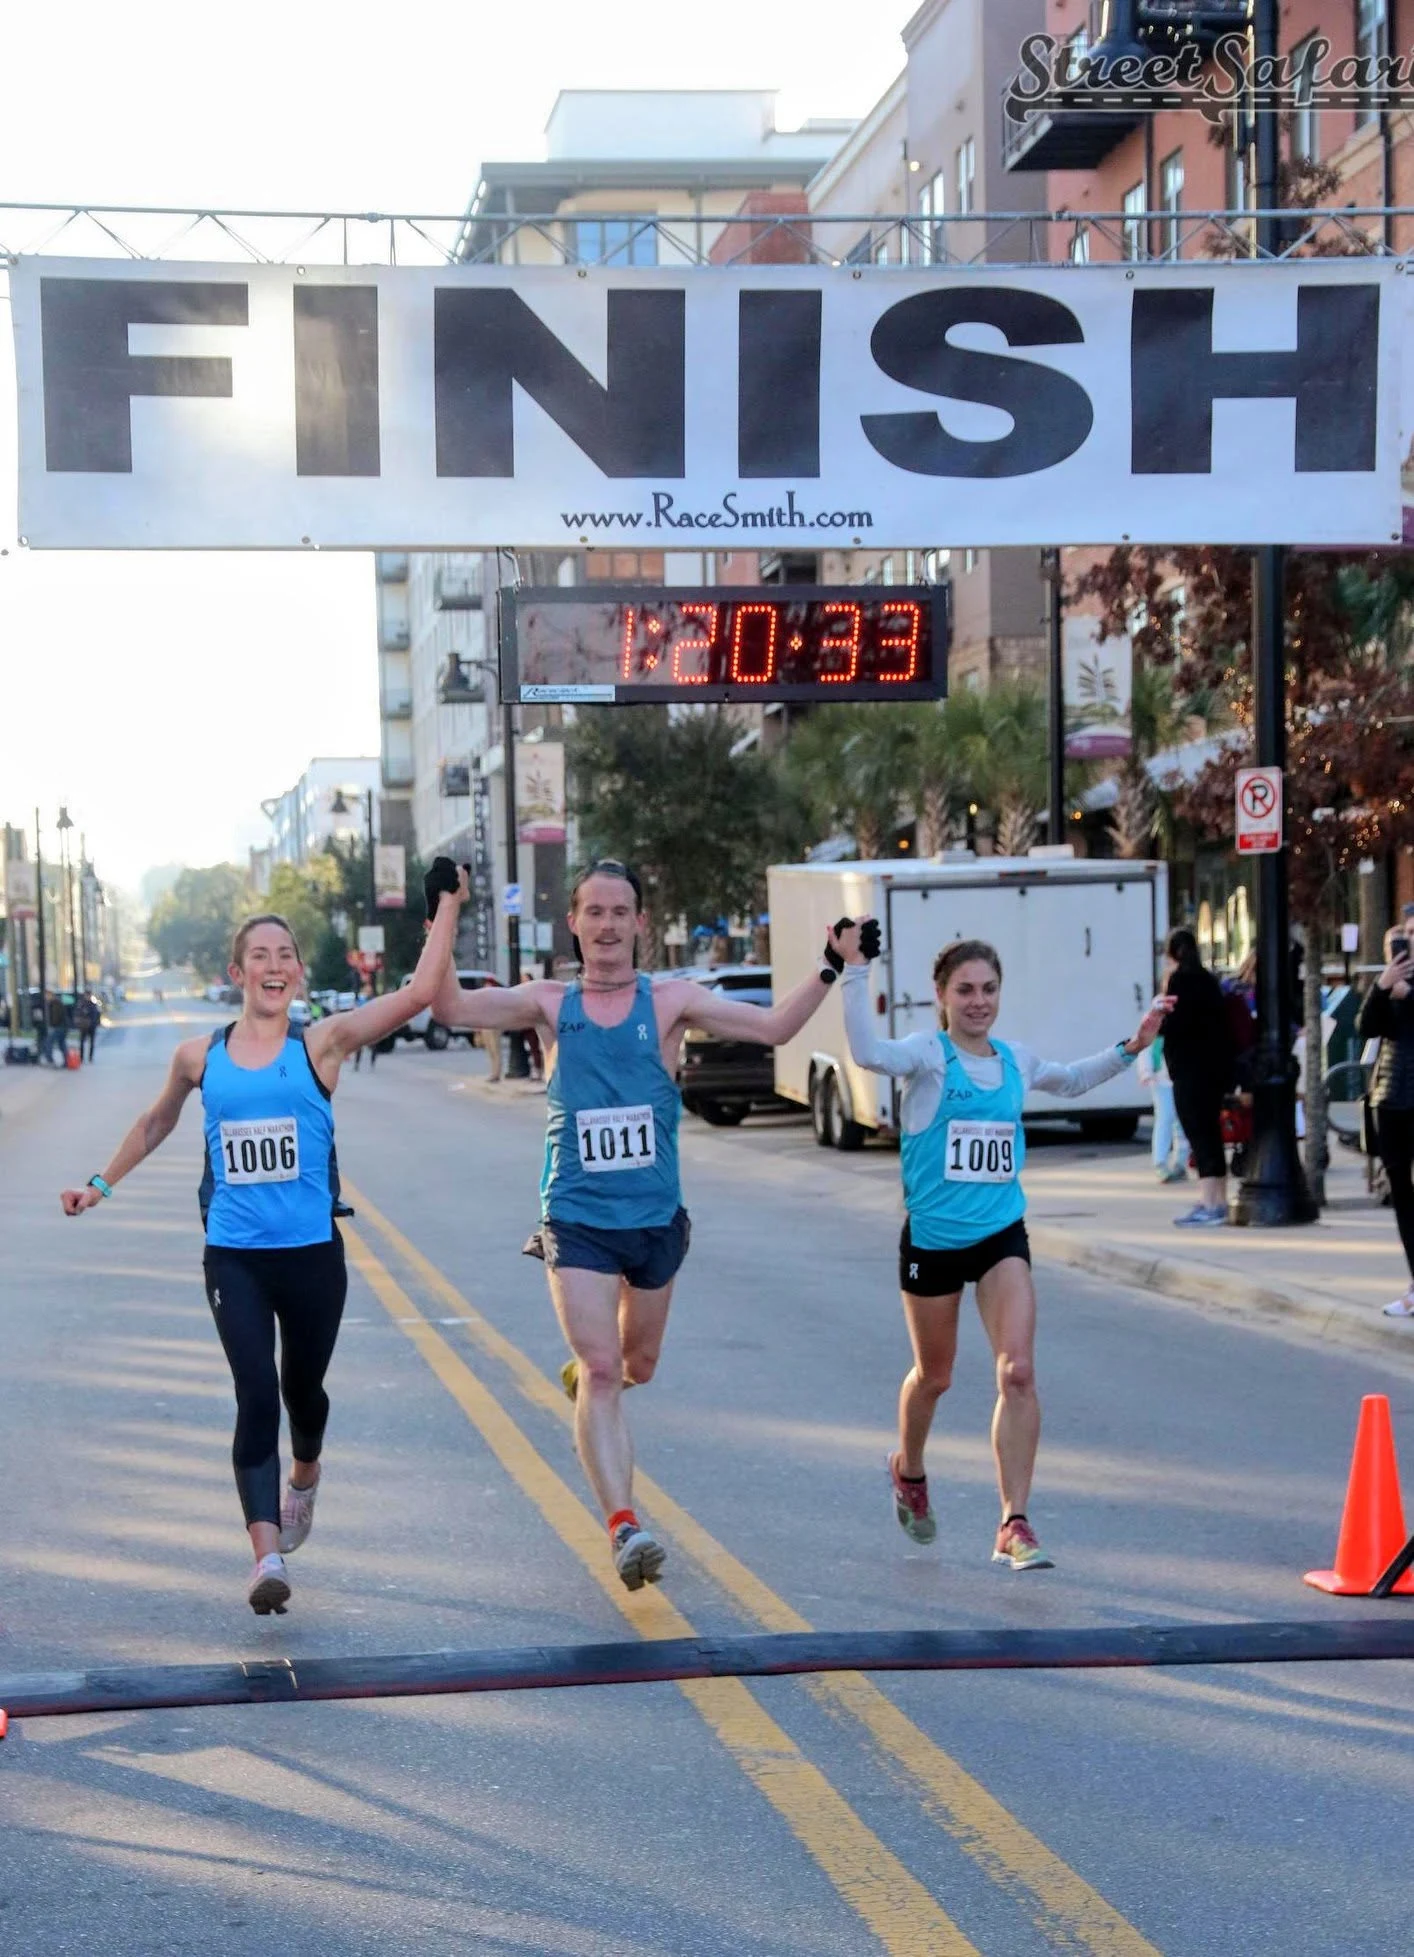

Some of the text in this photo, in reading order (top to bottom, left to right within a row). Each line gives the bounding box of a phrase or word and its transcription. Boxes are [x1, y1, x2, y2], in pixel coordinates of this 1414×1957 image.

[40, 277, 1381, 479] FINISH
[561, 490, 874, 528] www.RaceSmith.com
[226, 1136, 295, 1173] 1006
[582, 1124, 651, 1162] 1011
[950, 1138, 1013, 1172] 1009
